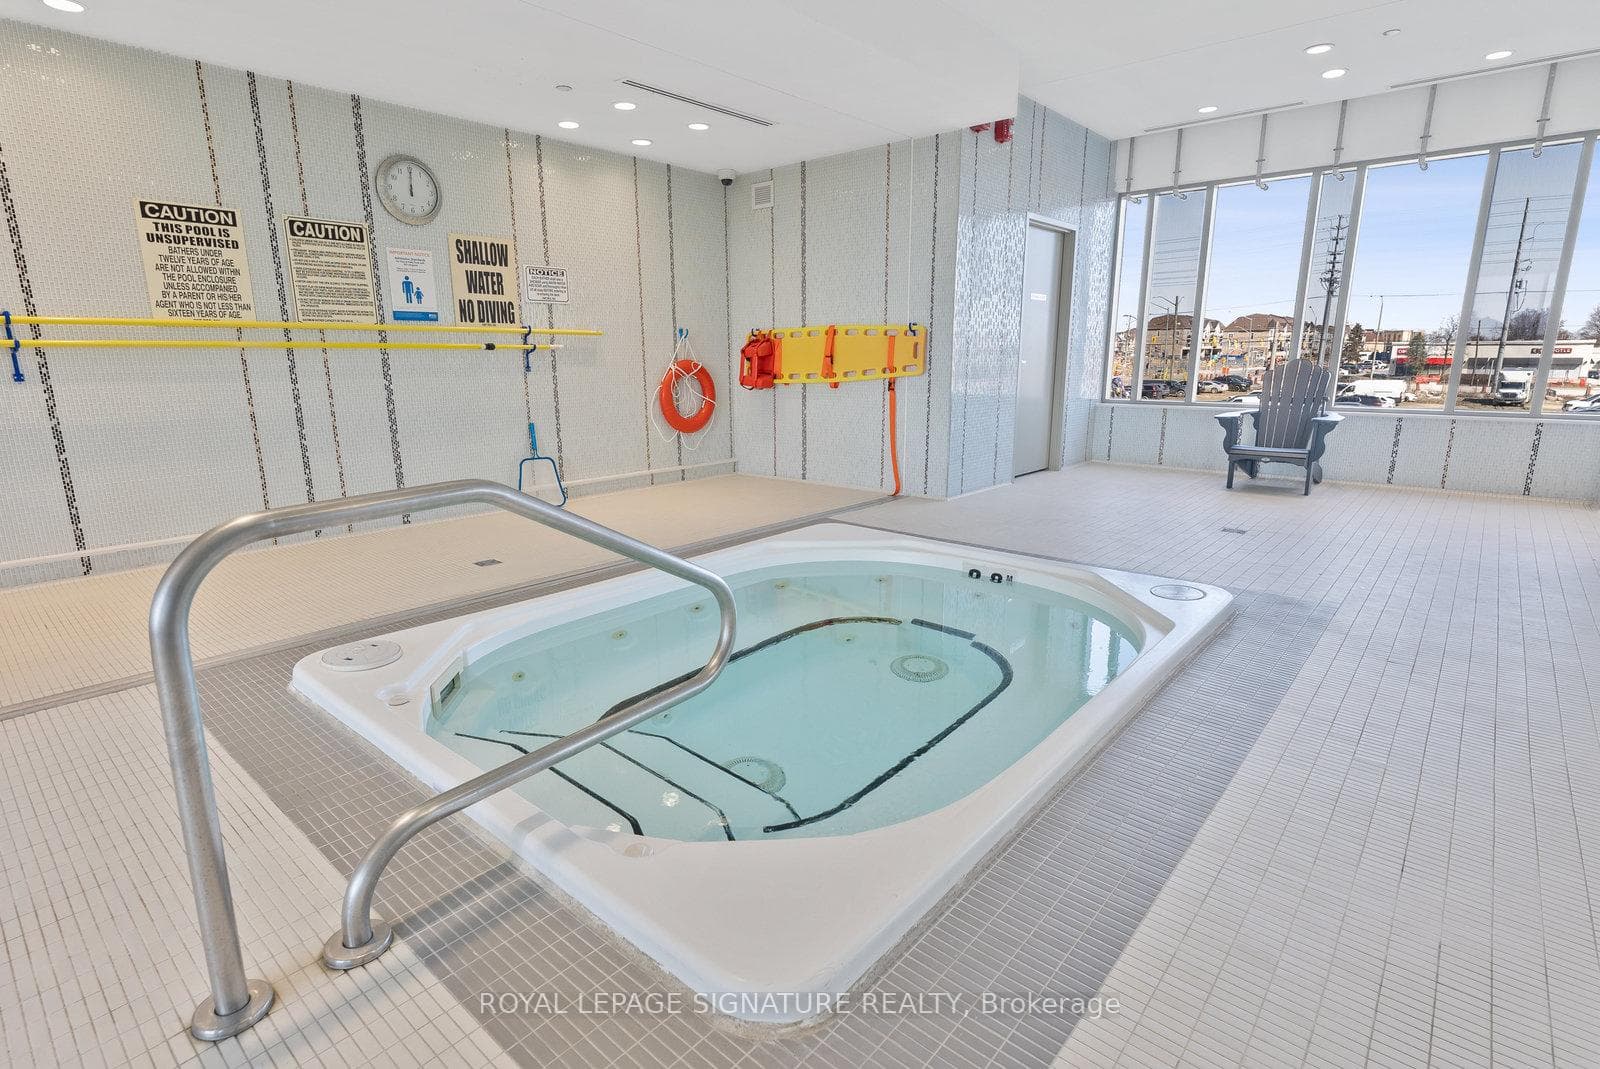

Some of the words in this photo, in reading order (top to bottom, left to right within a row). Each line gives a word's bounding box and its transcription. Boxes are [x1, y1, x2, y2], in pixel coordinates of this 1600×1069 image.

[144, 203, 234, 225] CAUTION
[152, 221, 183, 234] THIS
[185, 224, 216, 237] POOL
[218, 228, 231, 238] IS
[292, 220, 362, 242] CAUTION
[146, 232, 240, 250] UNSUPERVISED
[168, 246, 200, 257] BATHERS
[200, 249, 223, 258] UNDER
[455, 238, 509, 268] SHALLOW
[158, 254, 187, 264] TWELVE
[187, 256, 210, 266] YEARS
[211, 258, 220, 266] OF
[221, 259, 235, 267] AGE
[155, 263, 170, 272] ARE
[170, 264, 185, 273] NOT
[186, 265, 218, 275] ALLOWED
[219, 267, 241, 276] WITHIN
[528, 268, 565, 278] NOTICE
[162, 272, 177, 282] THE
[177, 273, 197, 283] POOL
[197, 274, 237, 285] ENCLOSURE
[464, 269, 505, 296] WATER
[163, 281, 191, 291] UNLESS
[191, 283, 238, 293] ACCOMPANIED
[161, 290, 171, 299] BY
[172, 291, 178, 299] A
[178, 291, 205, 301] PARENT
[205, 292, 216, 301] OR
[155, 300, 178, 309] AGENT
[179, 301, 195, 310] WHO
[195, 302, 202, 310] IS
[203, 302, 217, 310] NOT
[218, 302, 234, 311] LESS
[234, 303, 252, 311] THAN
[458, 298, 475, 324] NO
[476, 299, 516, 325] DIVING
[167, 309, 196, 318] SIXTEEN
[196, 310, 218, 319] YEARS
[218, 310, 228, 319] OF
